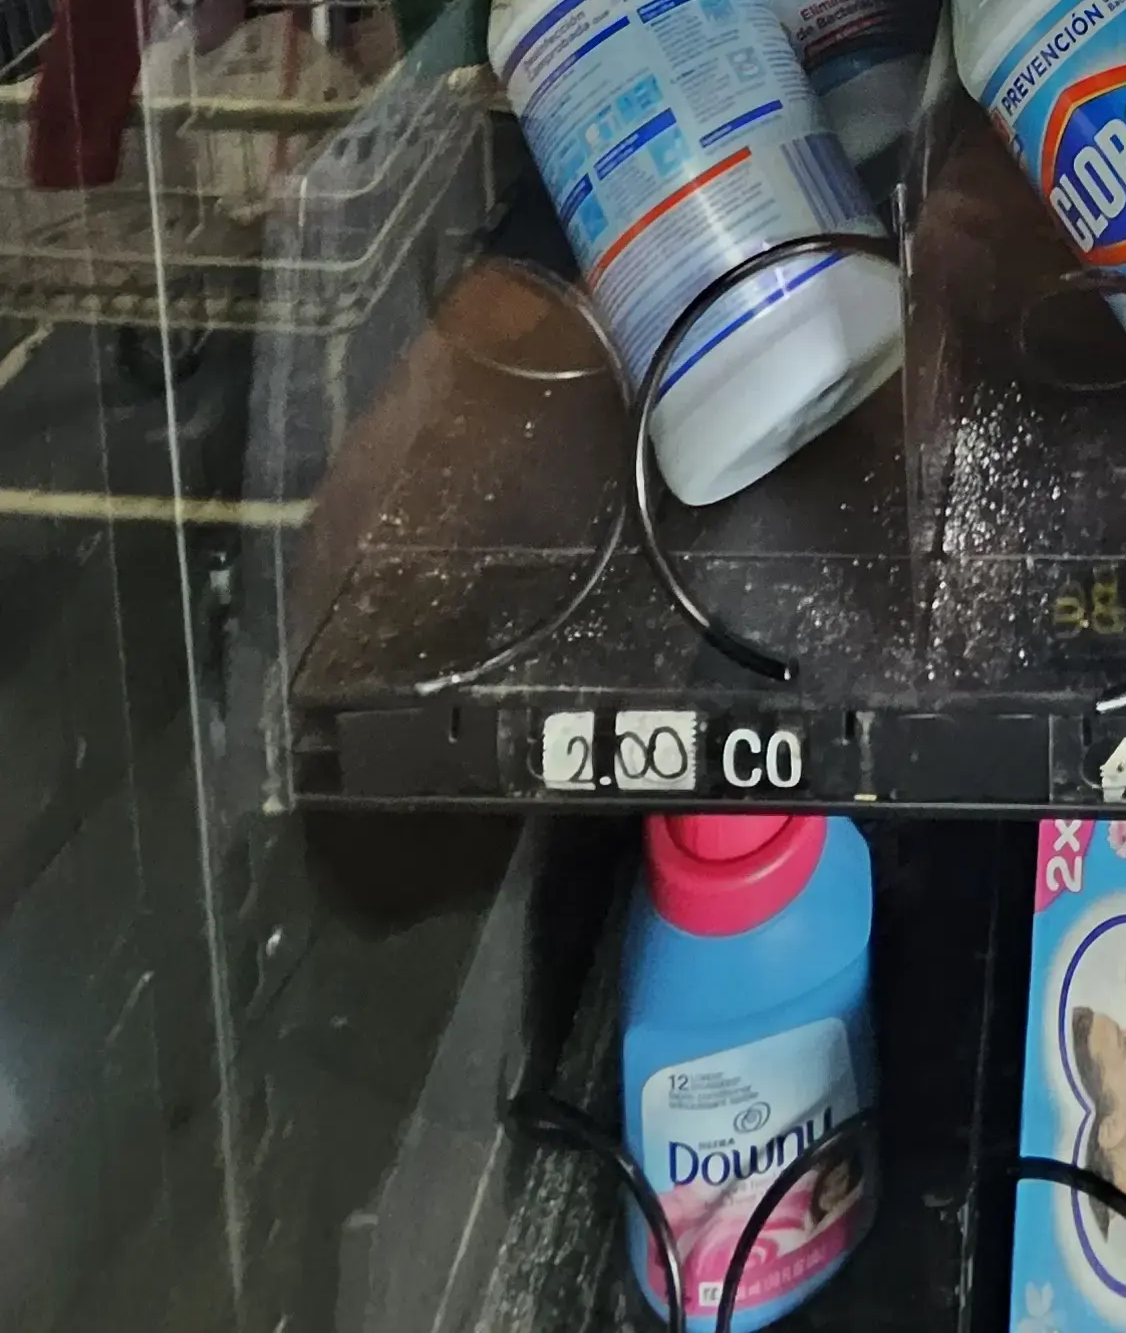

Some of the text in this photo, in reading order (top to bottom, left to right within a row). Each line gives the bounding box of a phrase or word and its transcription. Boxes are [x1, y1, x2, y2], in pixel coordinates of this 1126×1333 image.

[1001, 3, 1105, 117] PREVENCIÓN
[722, 730, 803, 789] C0
[1045, 820, 1086, 893] 2x
[667, 1074, 689, 1091] 12
[668, 1106, 834, 1188] Downy
